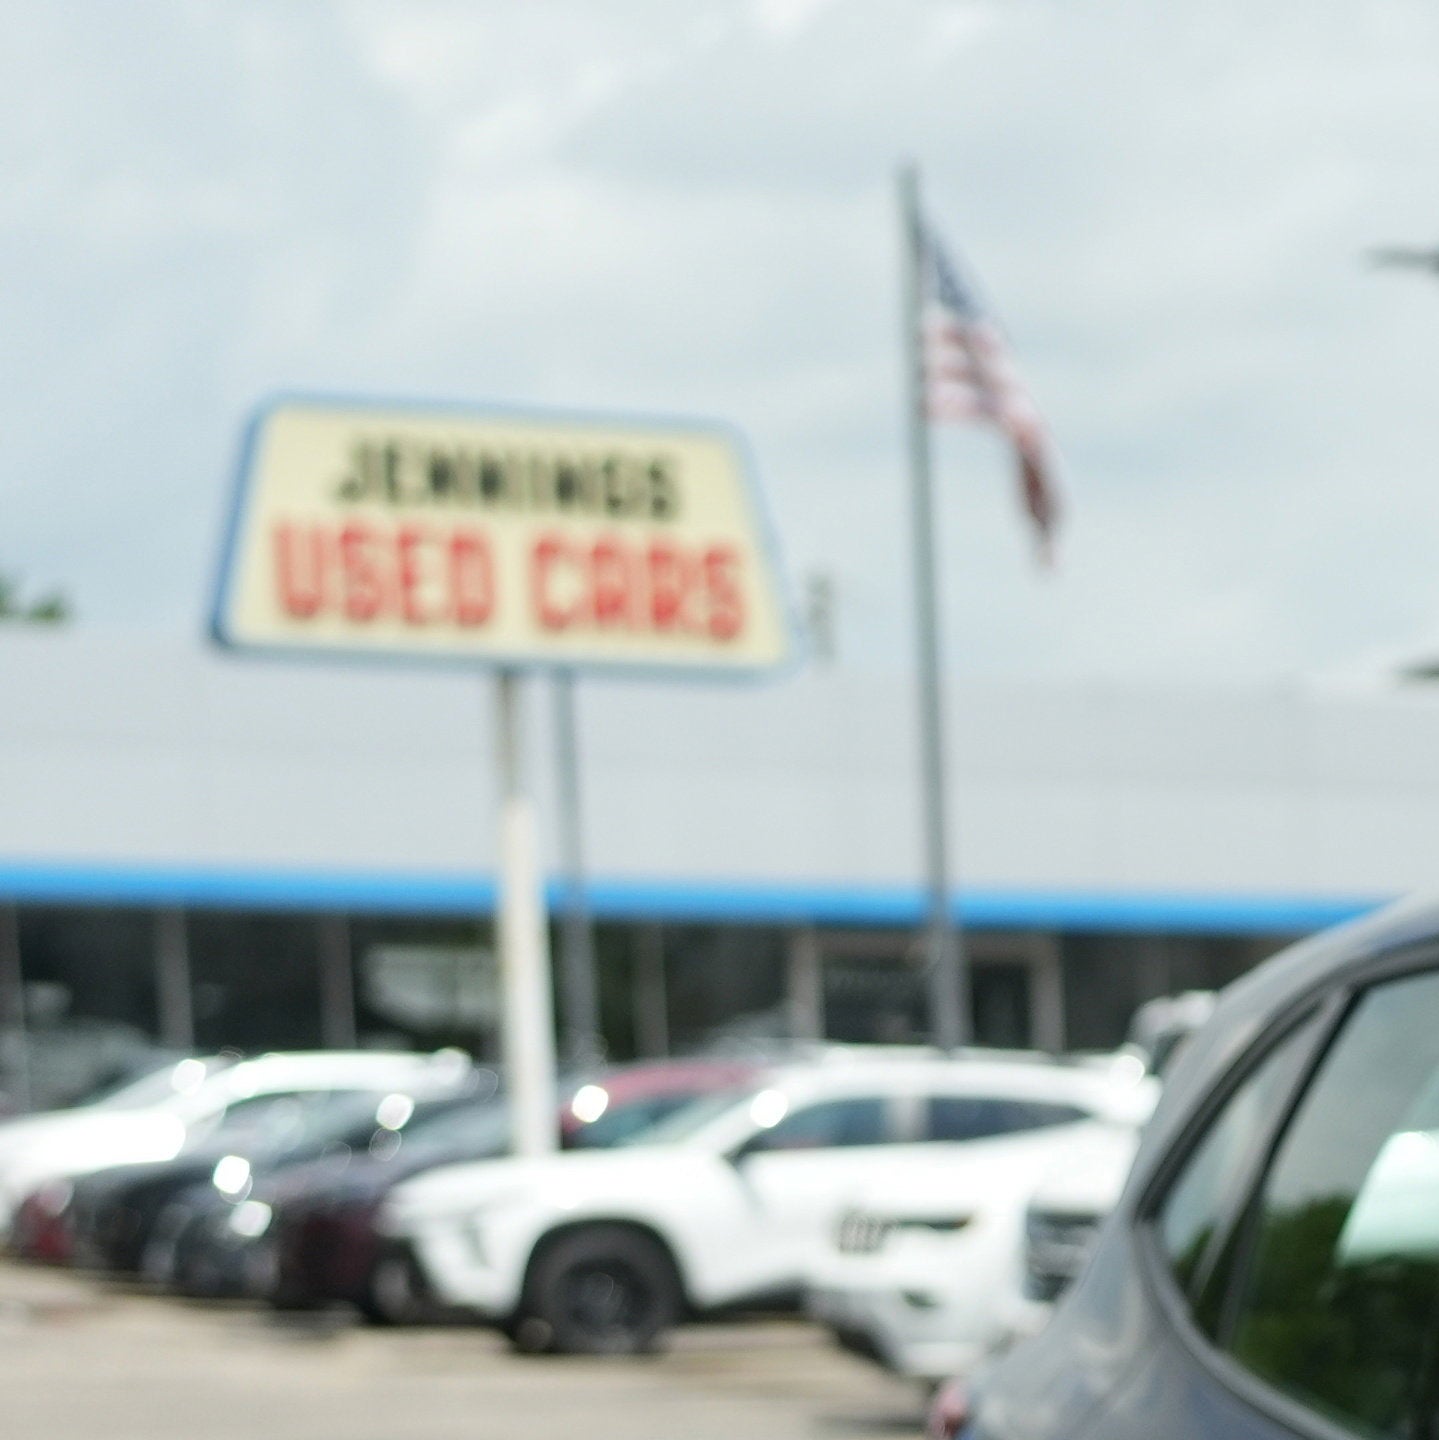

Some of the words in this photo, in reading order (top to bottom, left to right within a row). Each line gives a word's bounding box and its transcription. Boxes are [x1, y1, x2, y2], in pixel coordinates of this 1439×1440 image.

[336, 436, 679, 520] JENNINGS
[274, 520, 495, 625] USED
[532, 536, 745, 643] CARS
